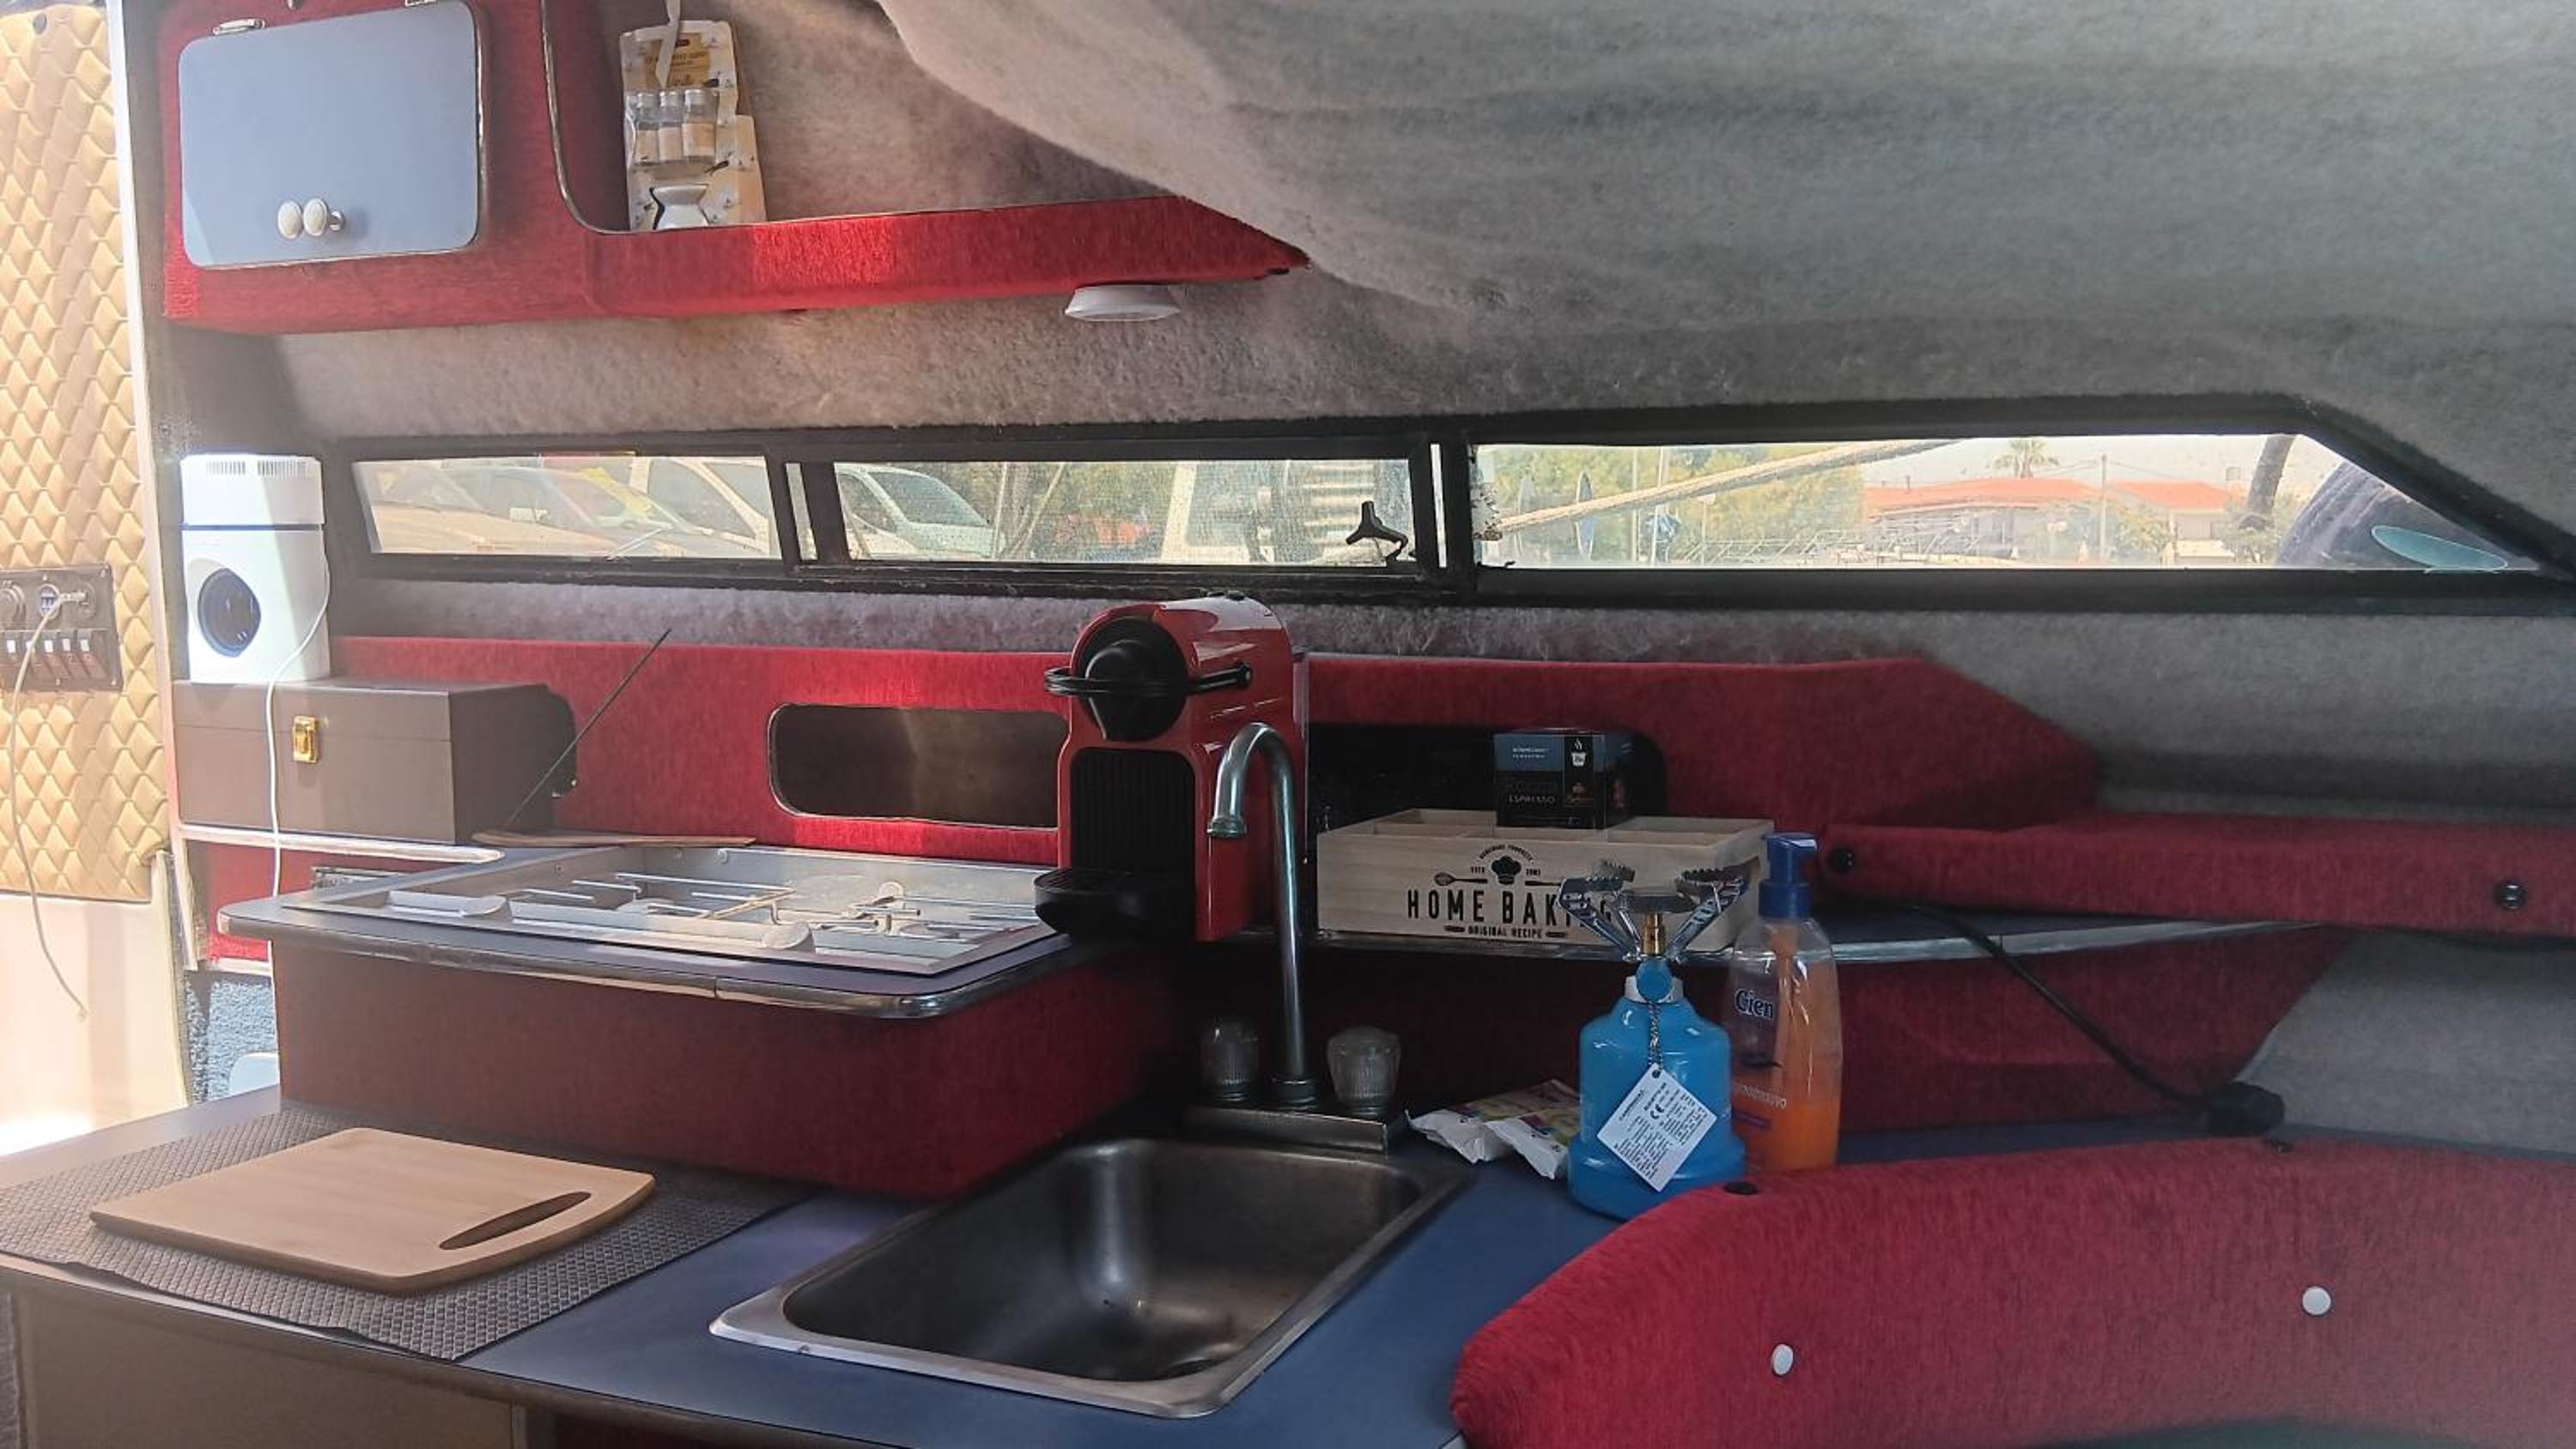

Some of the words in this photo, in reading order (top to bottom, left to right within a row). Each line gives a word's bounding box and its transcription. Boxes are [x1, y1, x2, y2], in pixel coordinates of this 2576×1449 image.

[1406, 889, 1485, 923] HOME
[1502, 892, 1612, 927] BAKG
[1467, 925, 1507, 937] ORIGINAL
[1510, 928, 1542, 939] RECIPE
